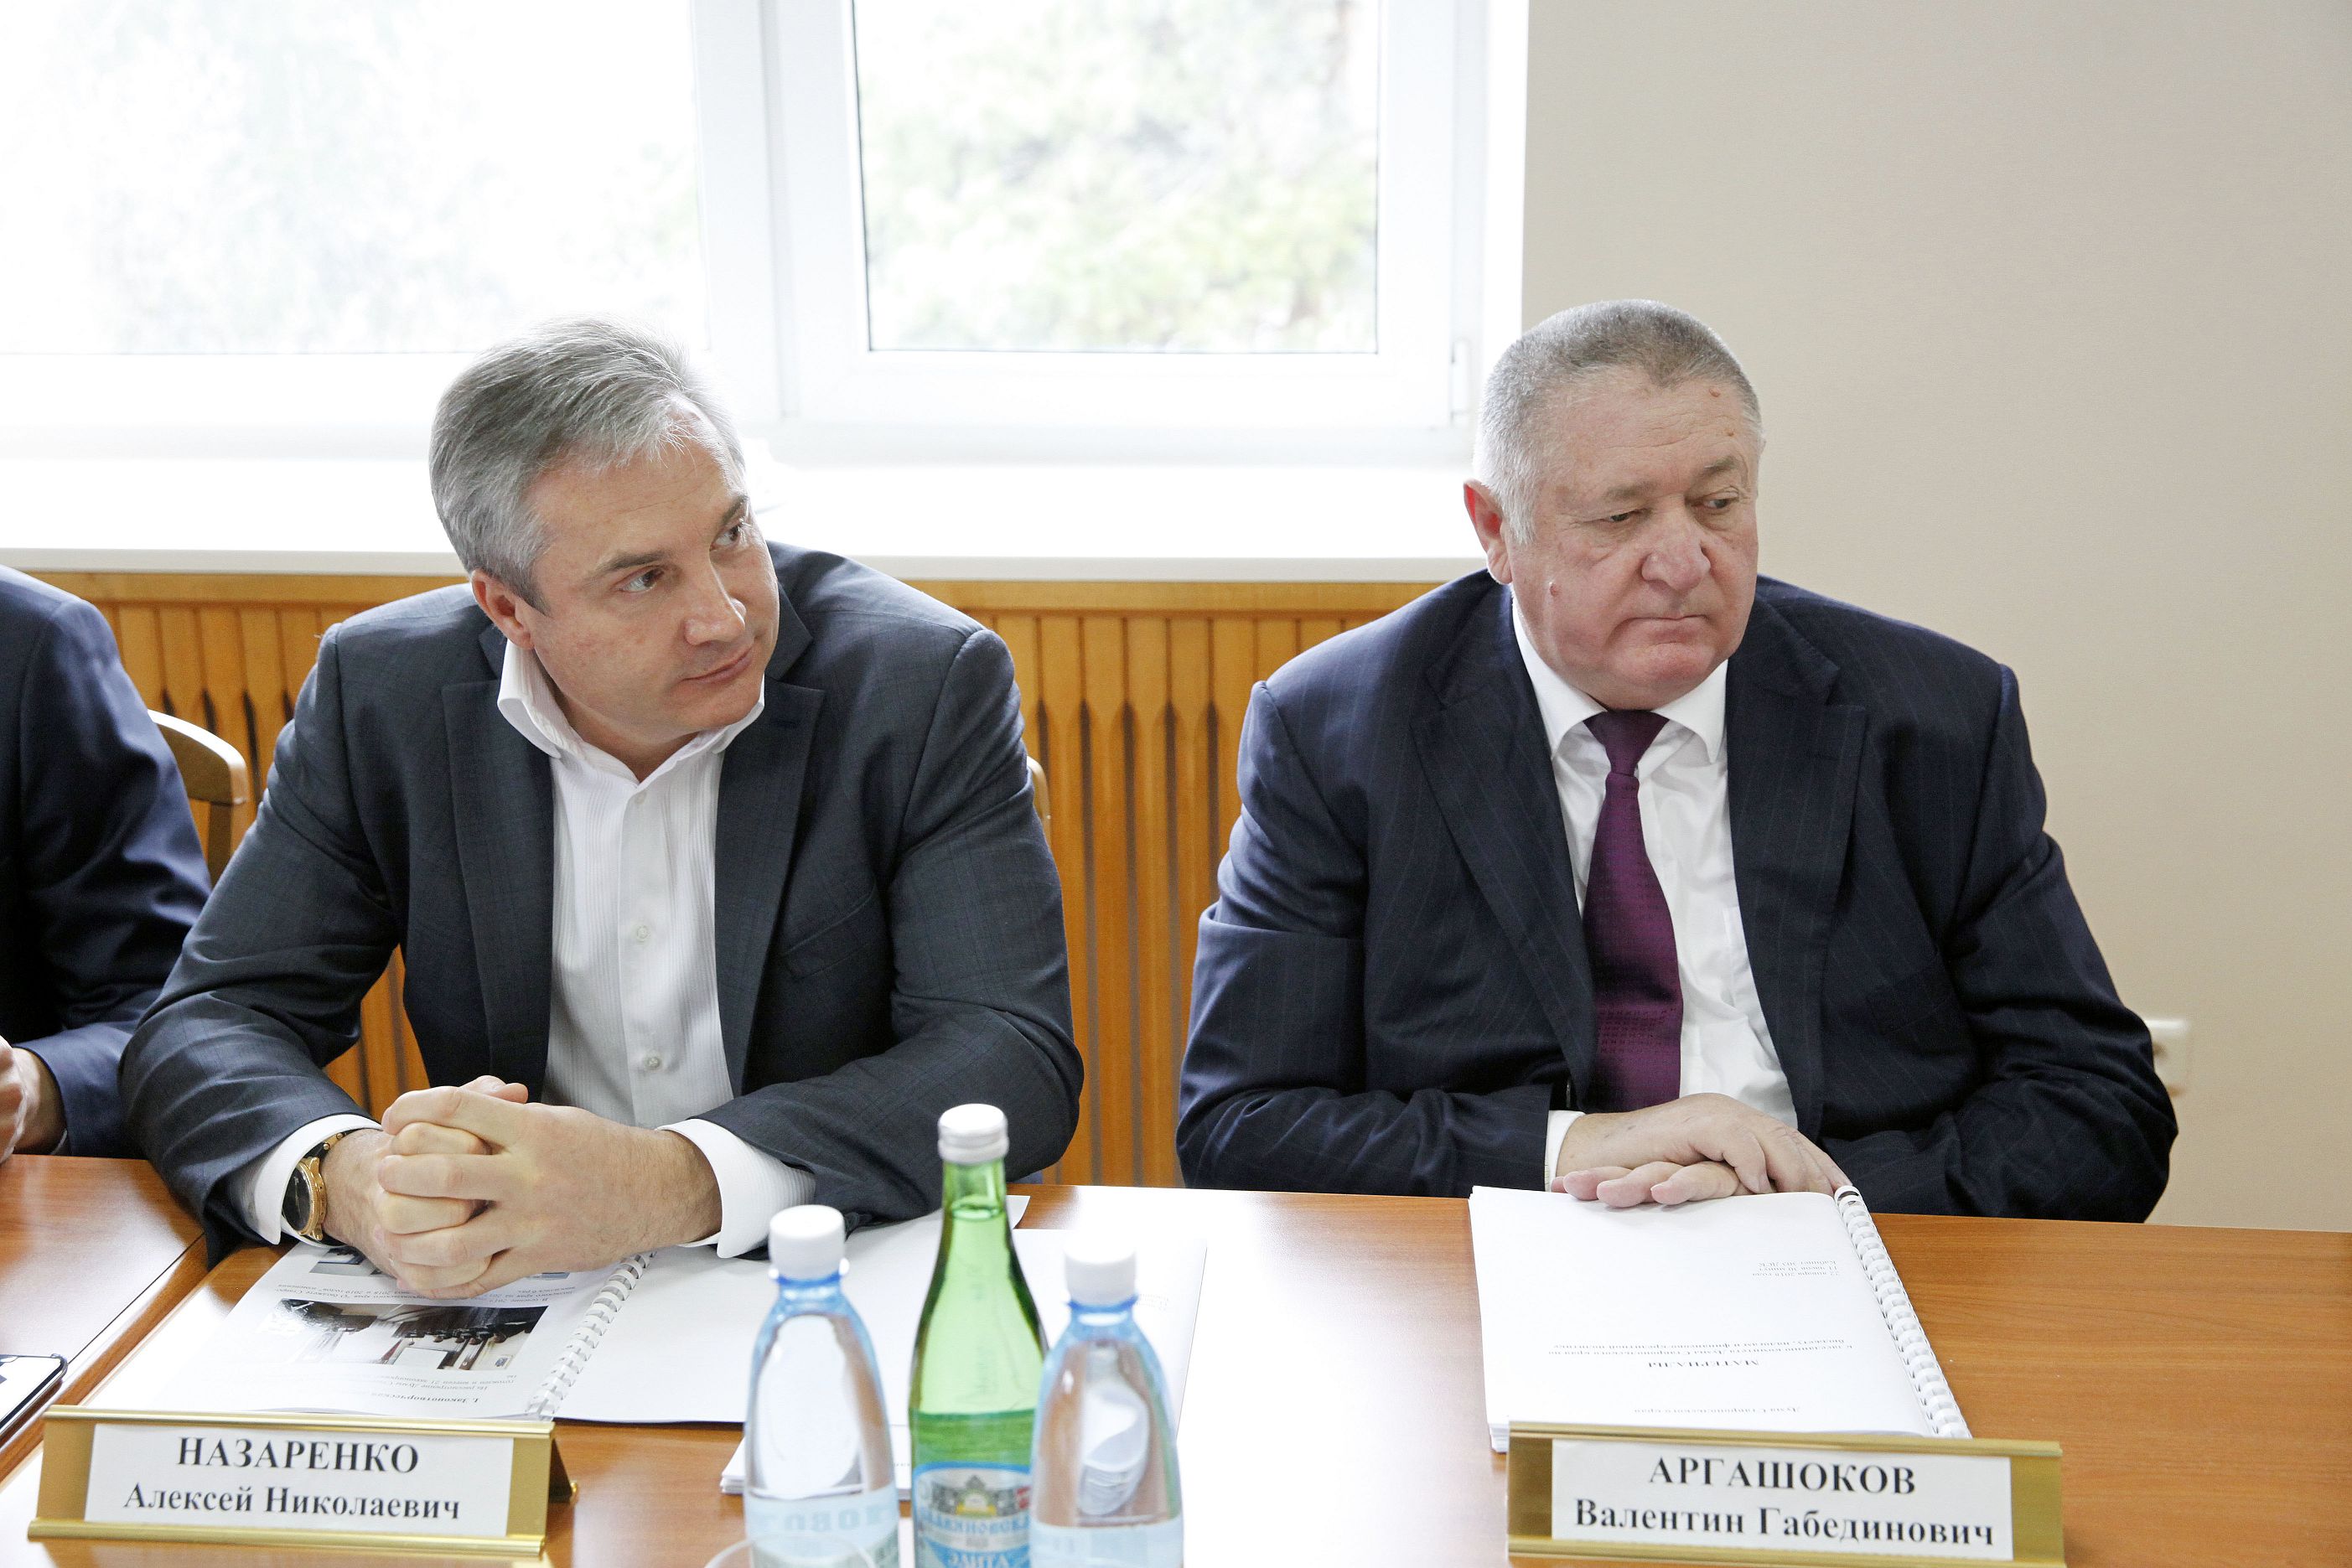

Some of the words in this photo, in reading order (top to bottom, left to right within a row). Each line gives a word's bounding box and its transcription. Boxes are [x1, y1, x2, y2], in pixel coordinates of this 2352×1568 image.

[1647, 1359, 1759, 1368] МАТЕРИАЛЫ
[175, 1436, 419, 1473] НАЗАРЕНКО
[1649, 1456, 1916, 1495] АРГАШОКОВ
[123, 1483, 254, 1513] Алексей
[265, 1486, 461, 1520] Николаевич
[1574, 1498, 1744, 1534] Валентин
[1759, 1507, 1995, 1546] Габединович
